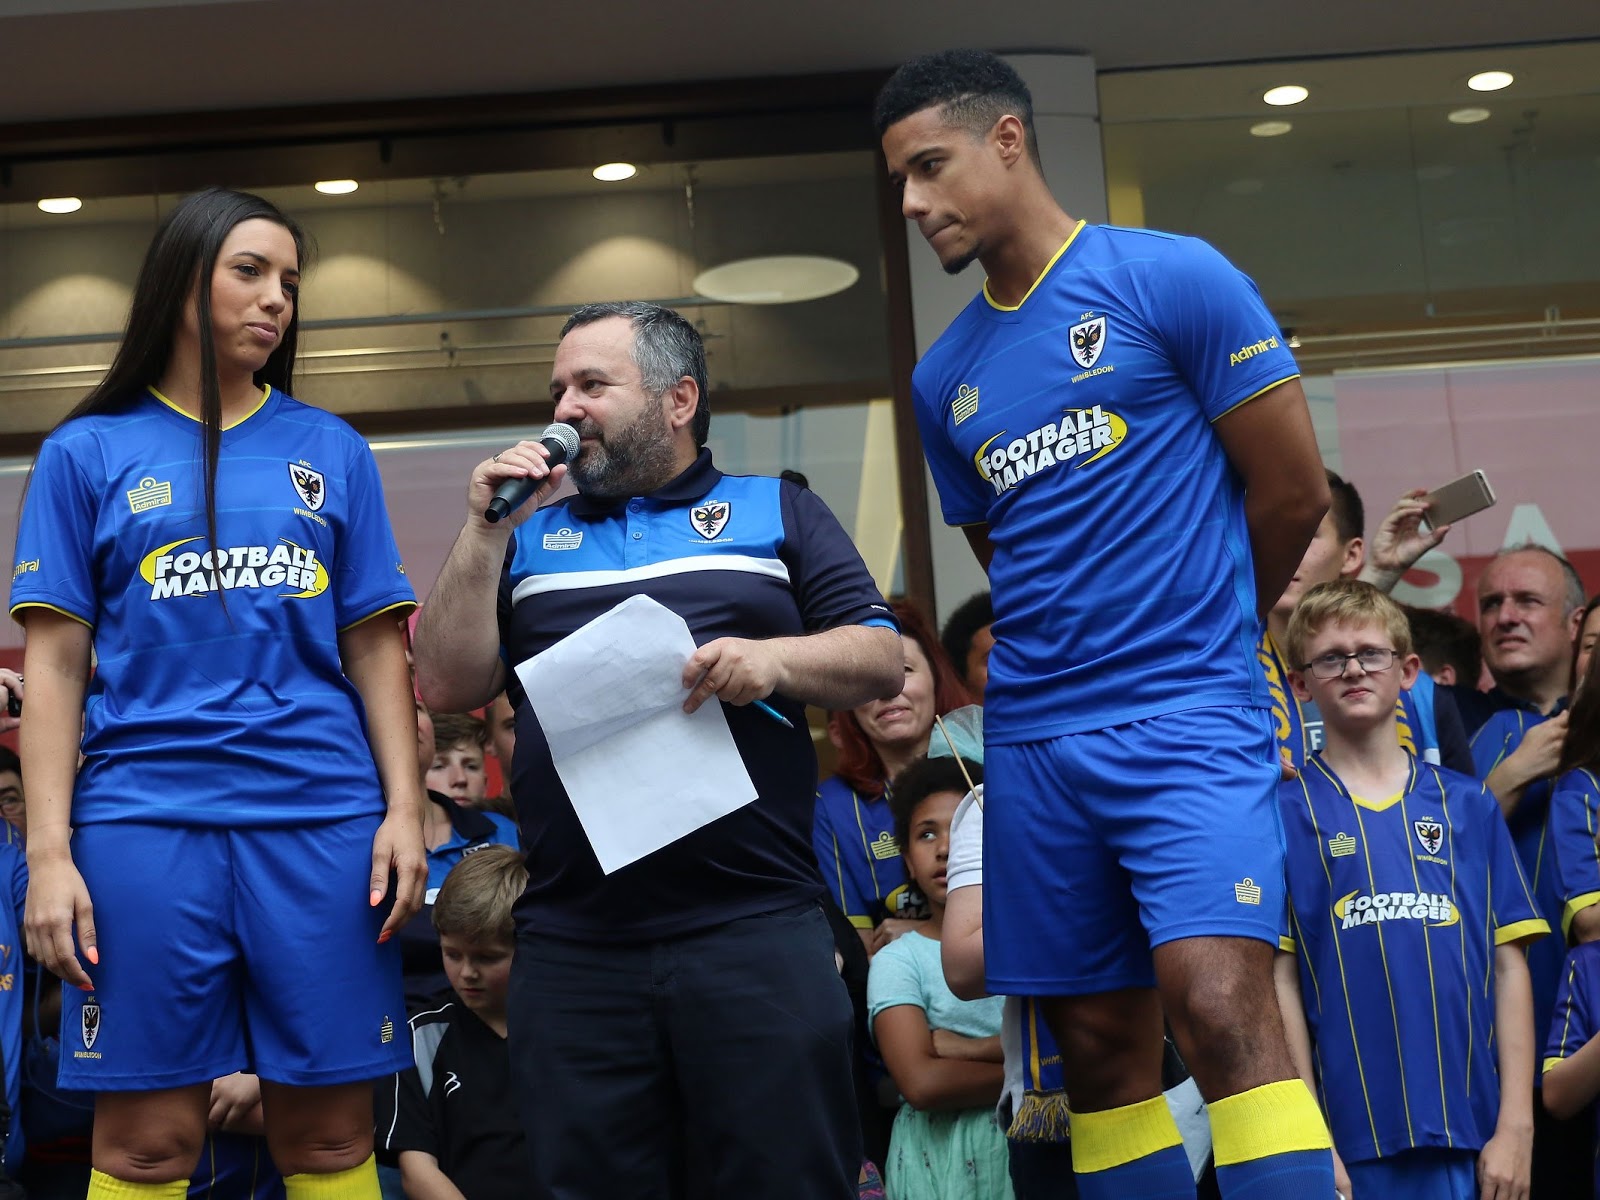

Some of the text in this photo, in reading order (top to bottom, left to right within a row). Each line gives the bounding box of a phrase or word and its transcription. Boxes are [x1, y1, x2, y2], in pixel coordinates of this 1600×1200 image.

[1080, 310, 1095, 321] AFC
[1229, 335, 1279, 367] Admiral
[1071, 365, 1114, 384] WIMBLEDON
[979, 404, 1110, 478] FOOTBALL
[299, 459, 312, 468] AFC
[988, 424, 1116, 496] MANAGER
[135, 495, 169, 511] Admiral
[294, 507, 327, 527] WIMBLEDON
[155, 544, 319, 578] FOOTBALL
[150, 564, 318, 600] MANAGER
[1416, 854, 1448, 866] WIMBLEDON
[1344, 892, 1451, 915] FOOTBALL
[1341, 904, 1452, 930] MANAGER
